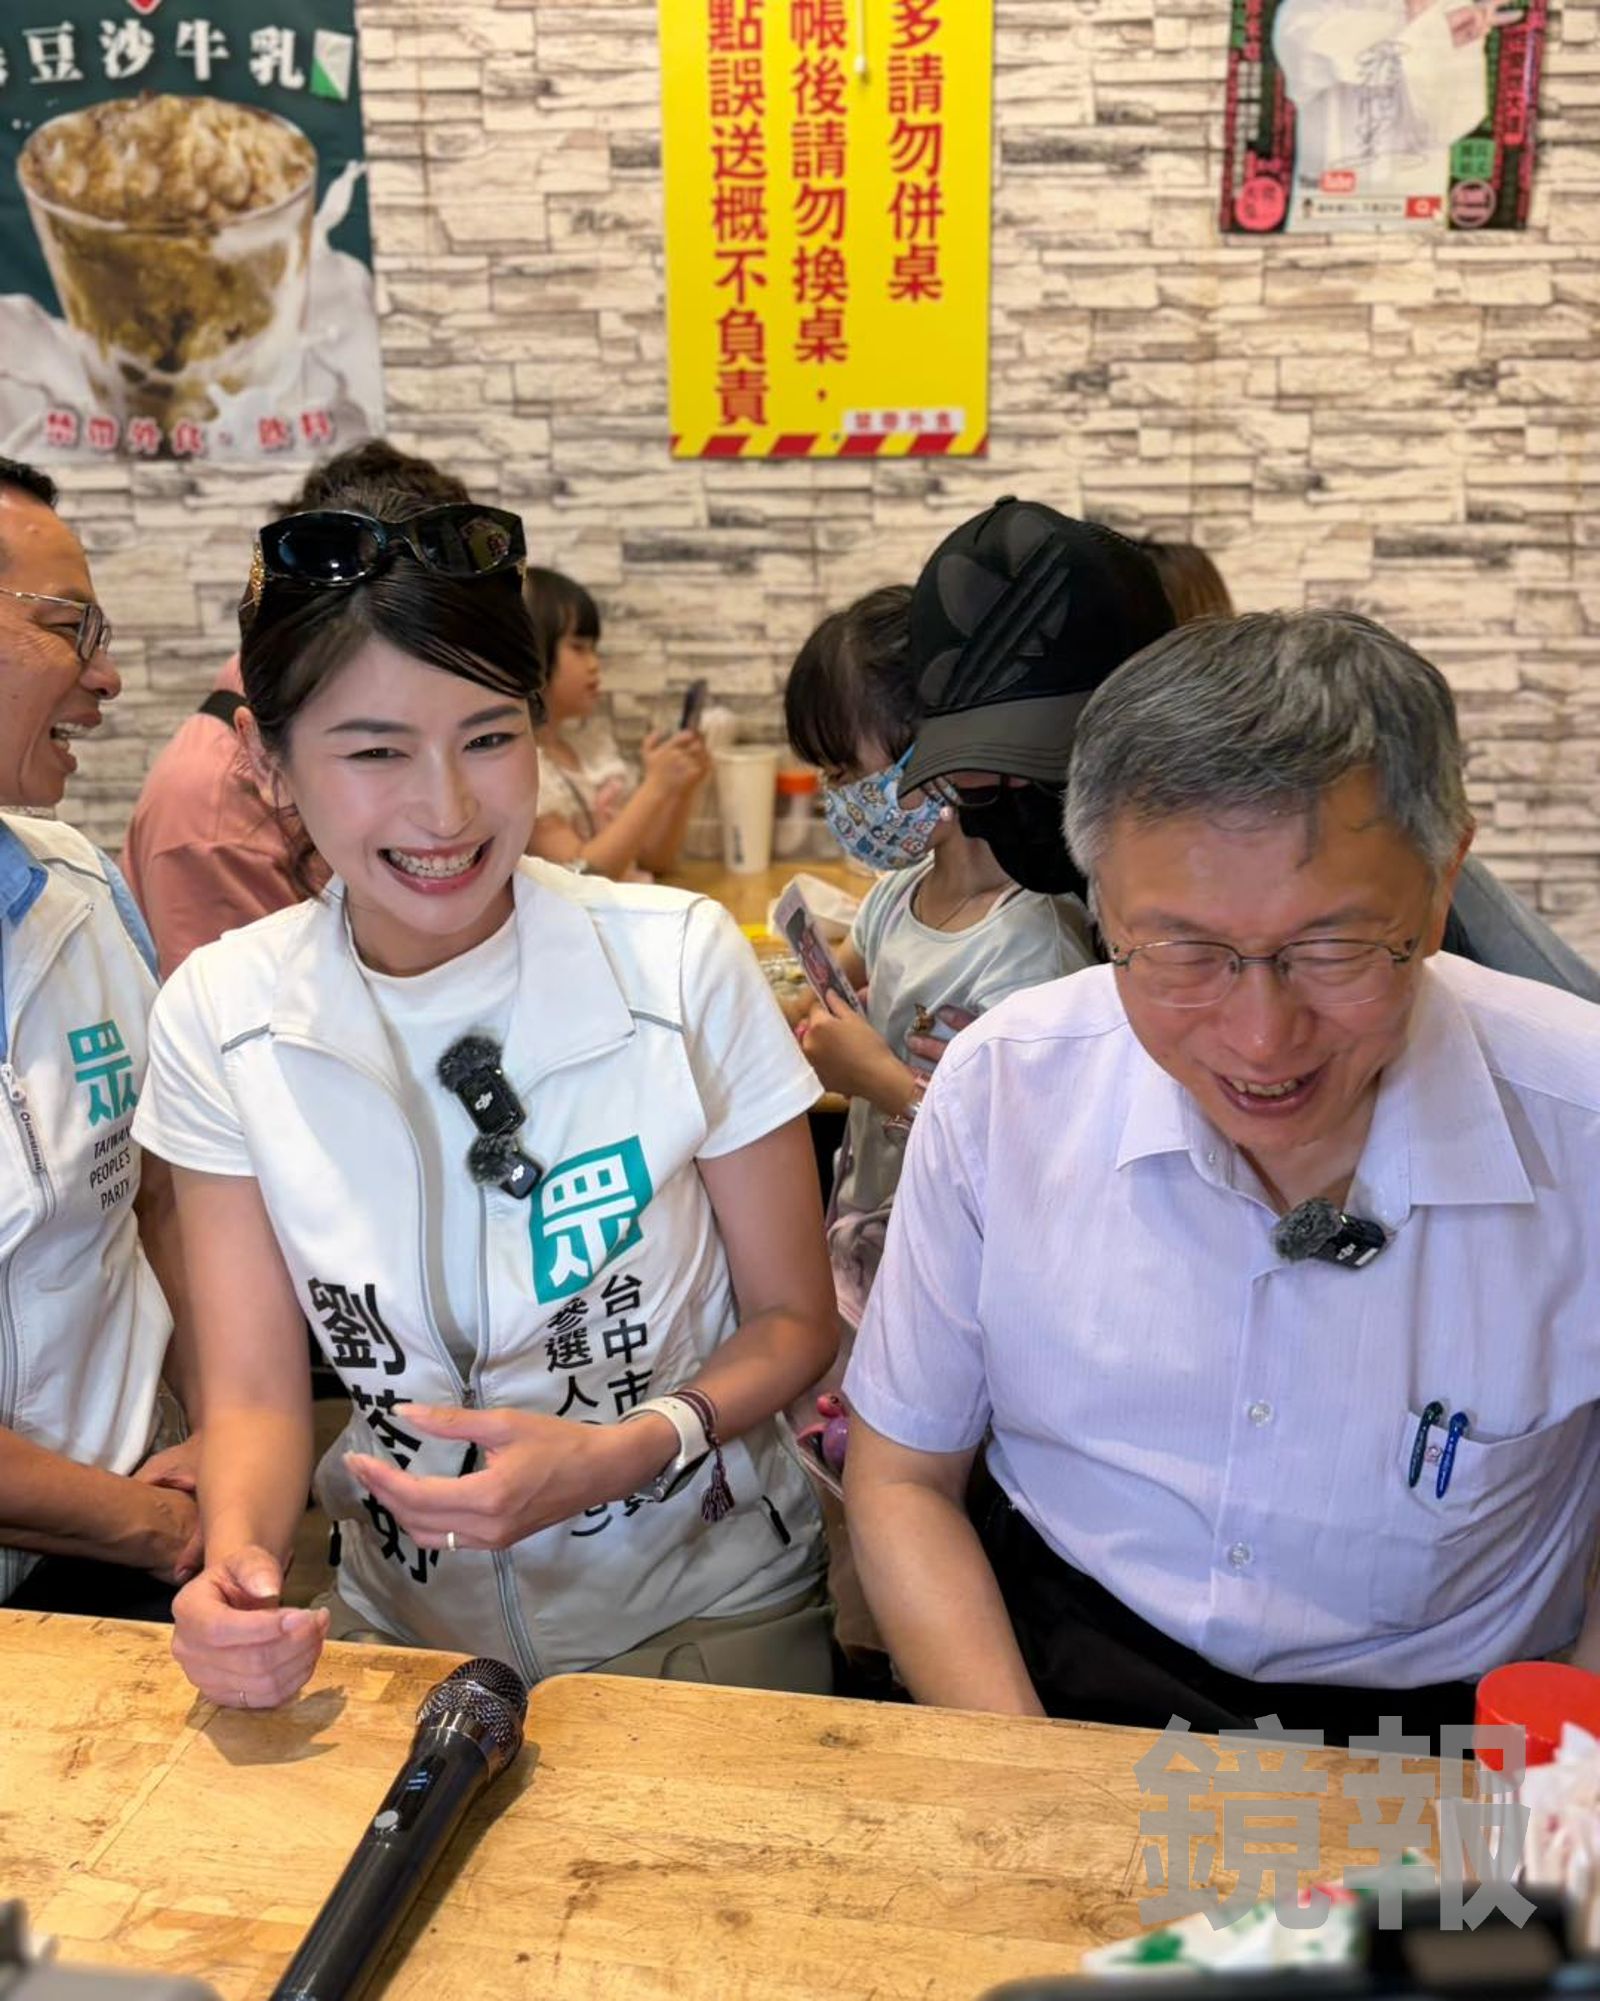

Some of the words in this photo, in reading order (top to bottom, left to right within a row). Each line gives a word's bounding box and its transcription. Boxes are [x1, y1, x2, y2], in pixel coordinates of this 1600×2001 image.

[0, 19, 305, 90] 豆沙牛乳
[887, 0, 944, 302] 多請勿併桌
[100, 1178, 130, 1211] PARTY
